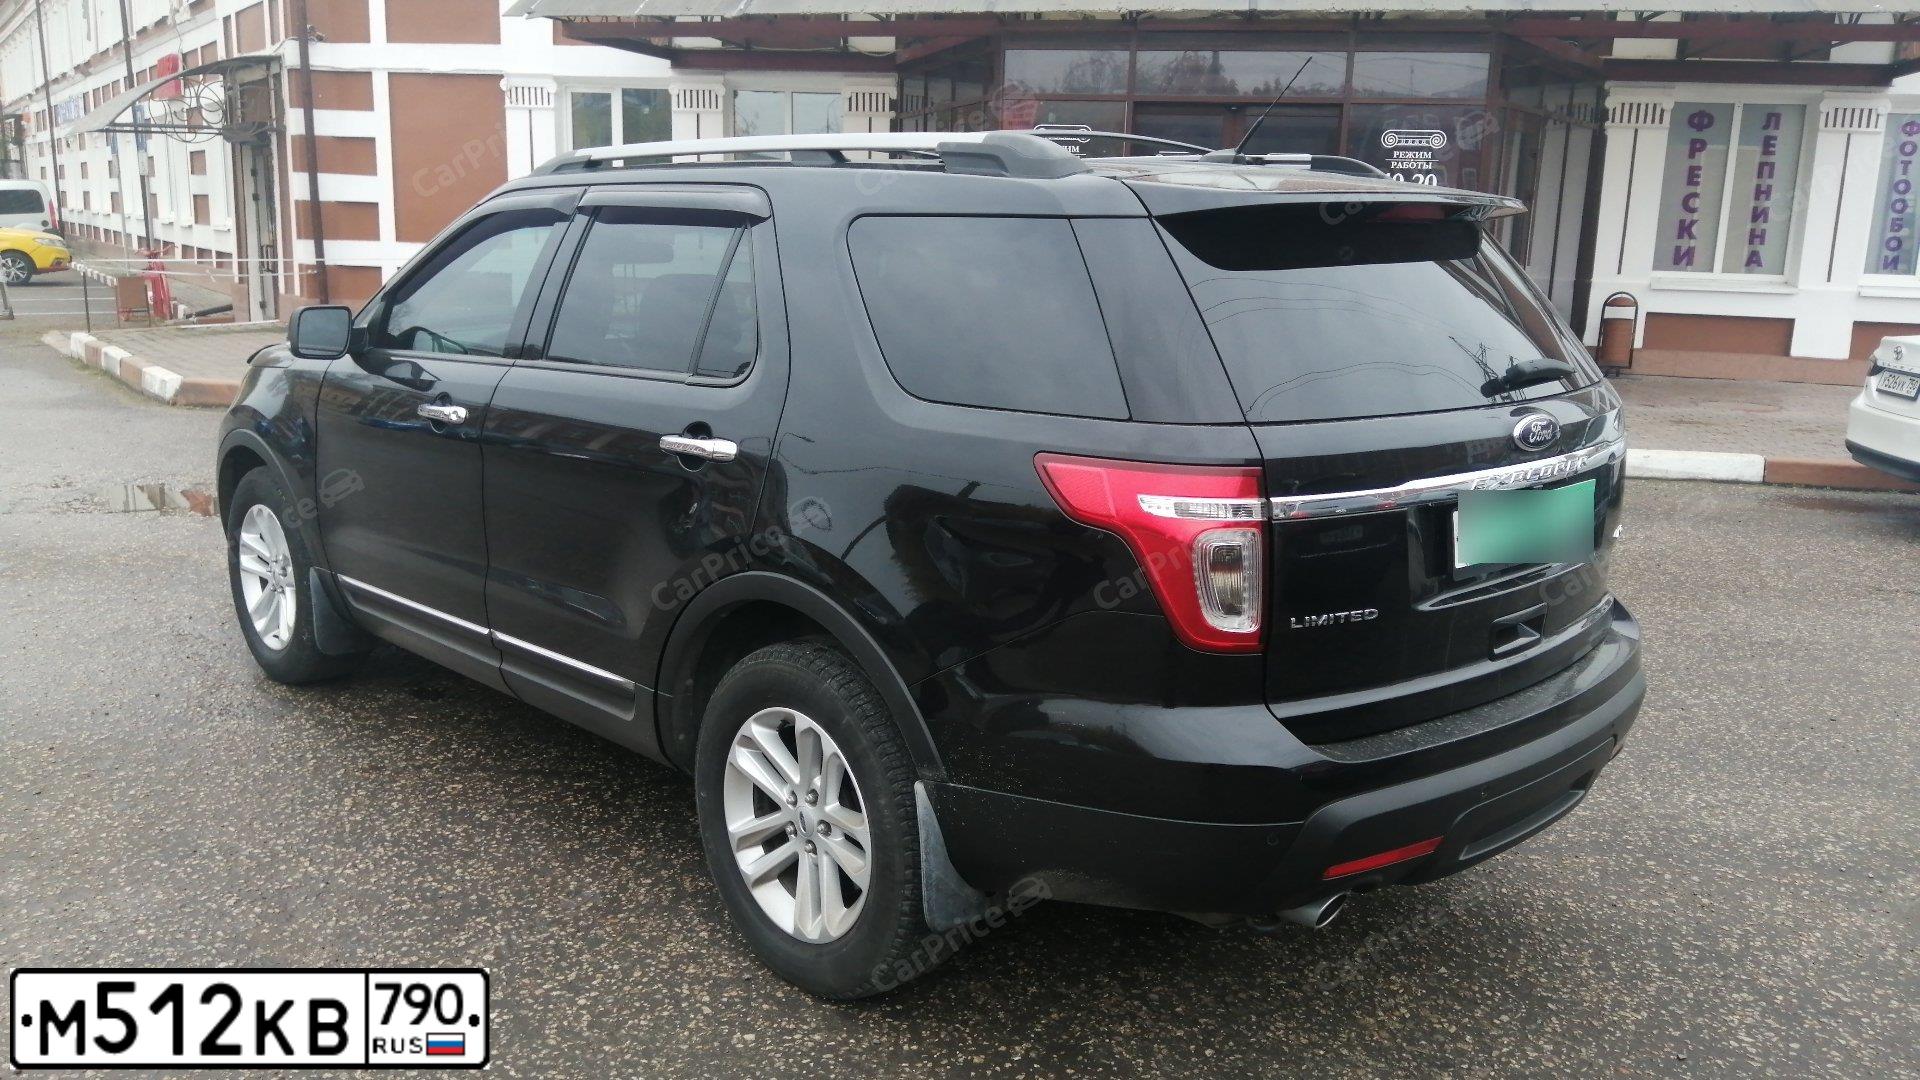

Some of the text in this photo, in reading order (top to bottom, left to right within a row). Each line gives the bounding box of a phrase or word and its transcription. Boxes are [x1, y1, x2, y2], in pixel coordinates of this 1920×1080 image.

[1391, 161, 1432, 169] РАБОТЫ
[1393, 151, 1432, 159] РЕЖИМ
[1672, 110, 1715, 266] ФРЕСКИ
[1745, 112, 1782, 267] ЛЕПНИНА
[1882, 120, 1920, 271] ФОТООБОИ
[1529, 420, 1554, 443] Ford
[1290, 608, 1379, 629] LIMITED
